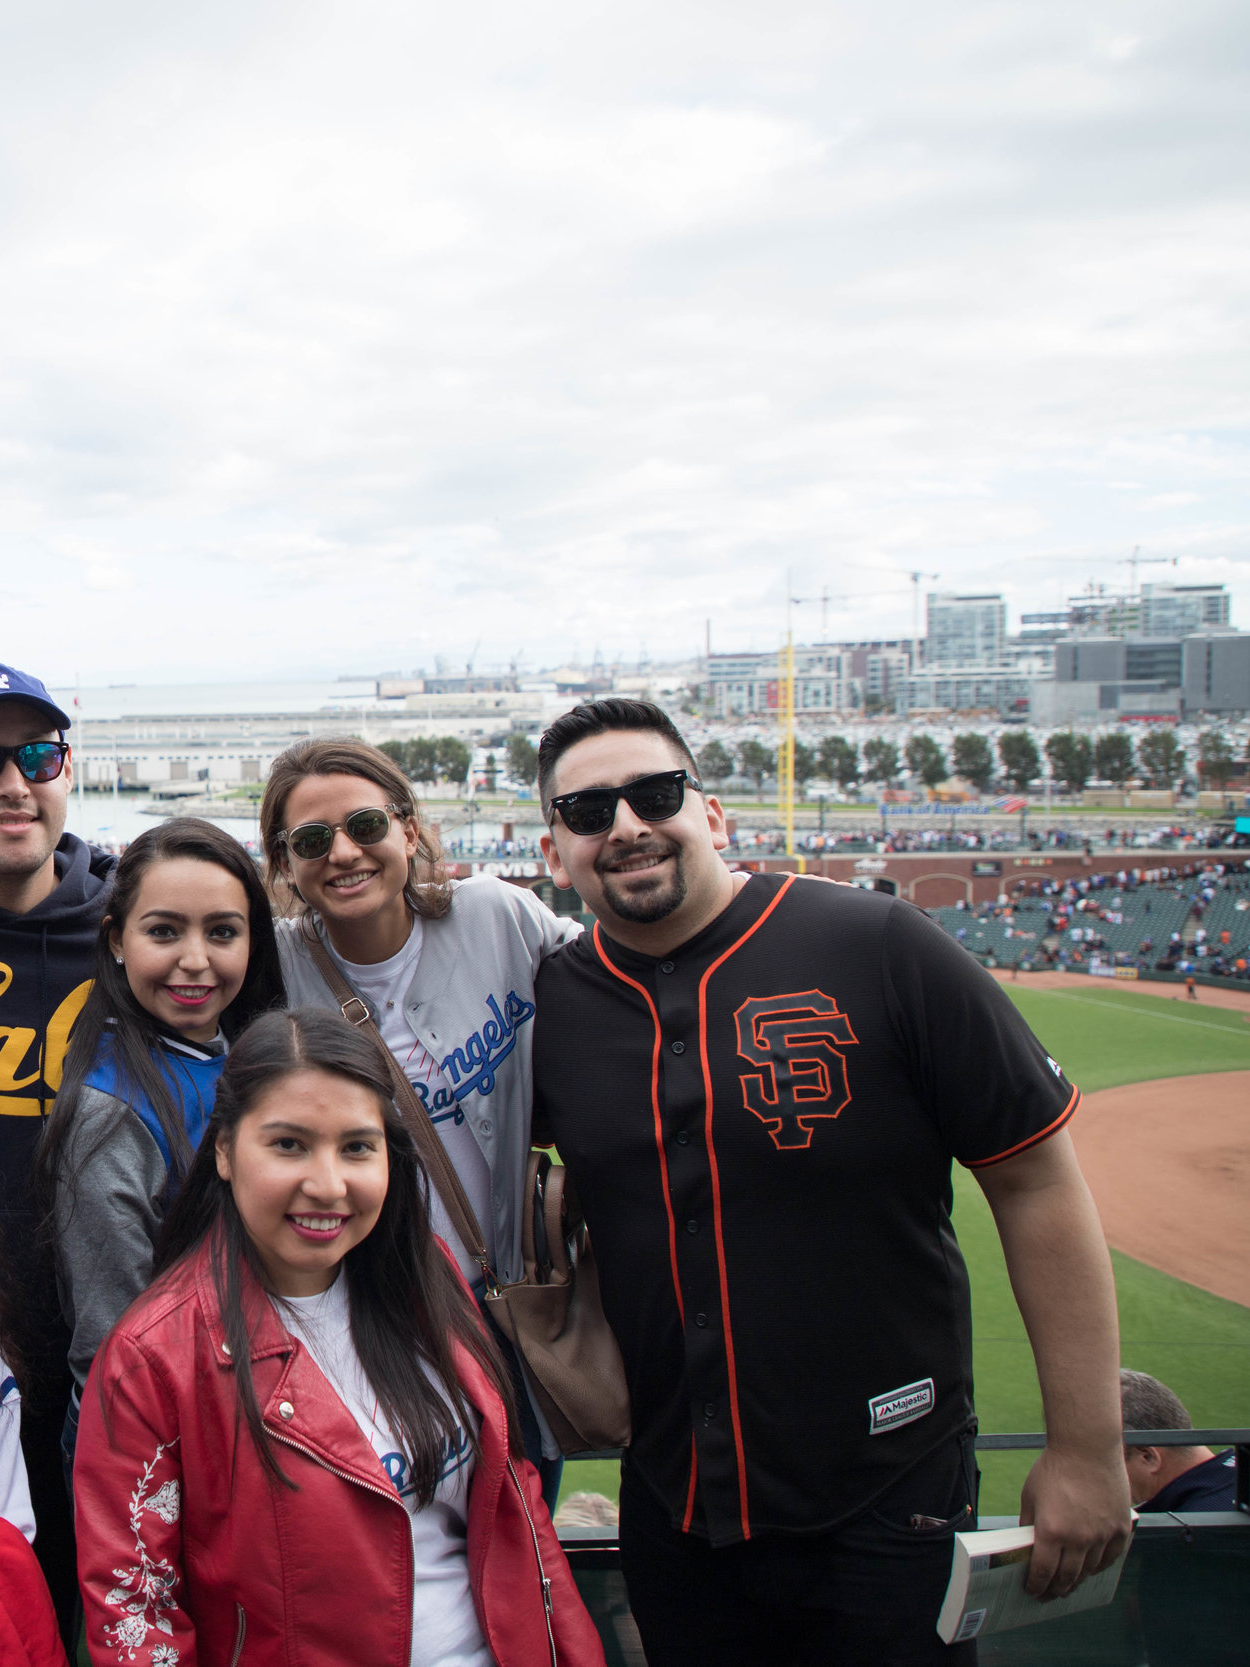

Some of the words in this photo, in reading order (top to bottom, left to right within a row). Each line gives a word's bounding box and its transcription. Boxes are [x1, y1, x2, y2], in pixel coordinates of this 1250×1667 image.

[879, 803, 913, 815] Bank
[916, 804, 931, 815] of
[933, 803, 991, 815] America
[733, 988, 860, 1150] SF
[892, 1393, 927, 1411] Majestic
